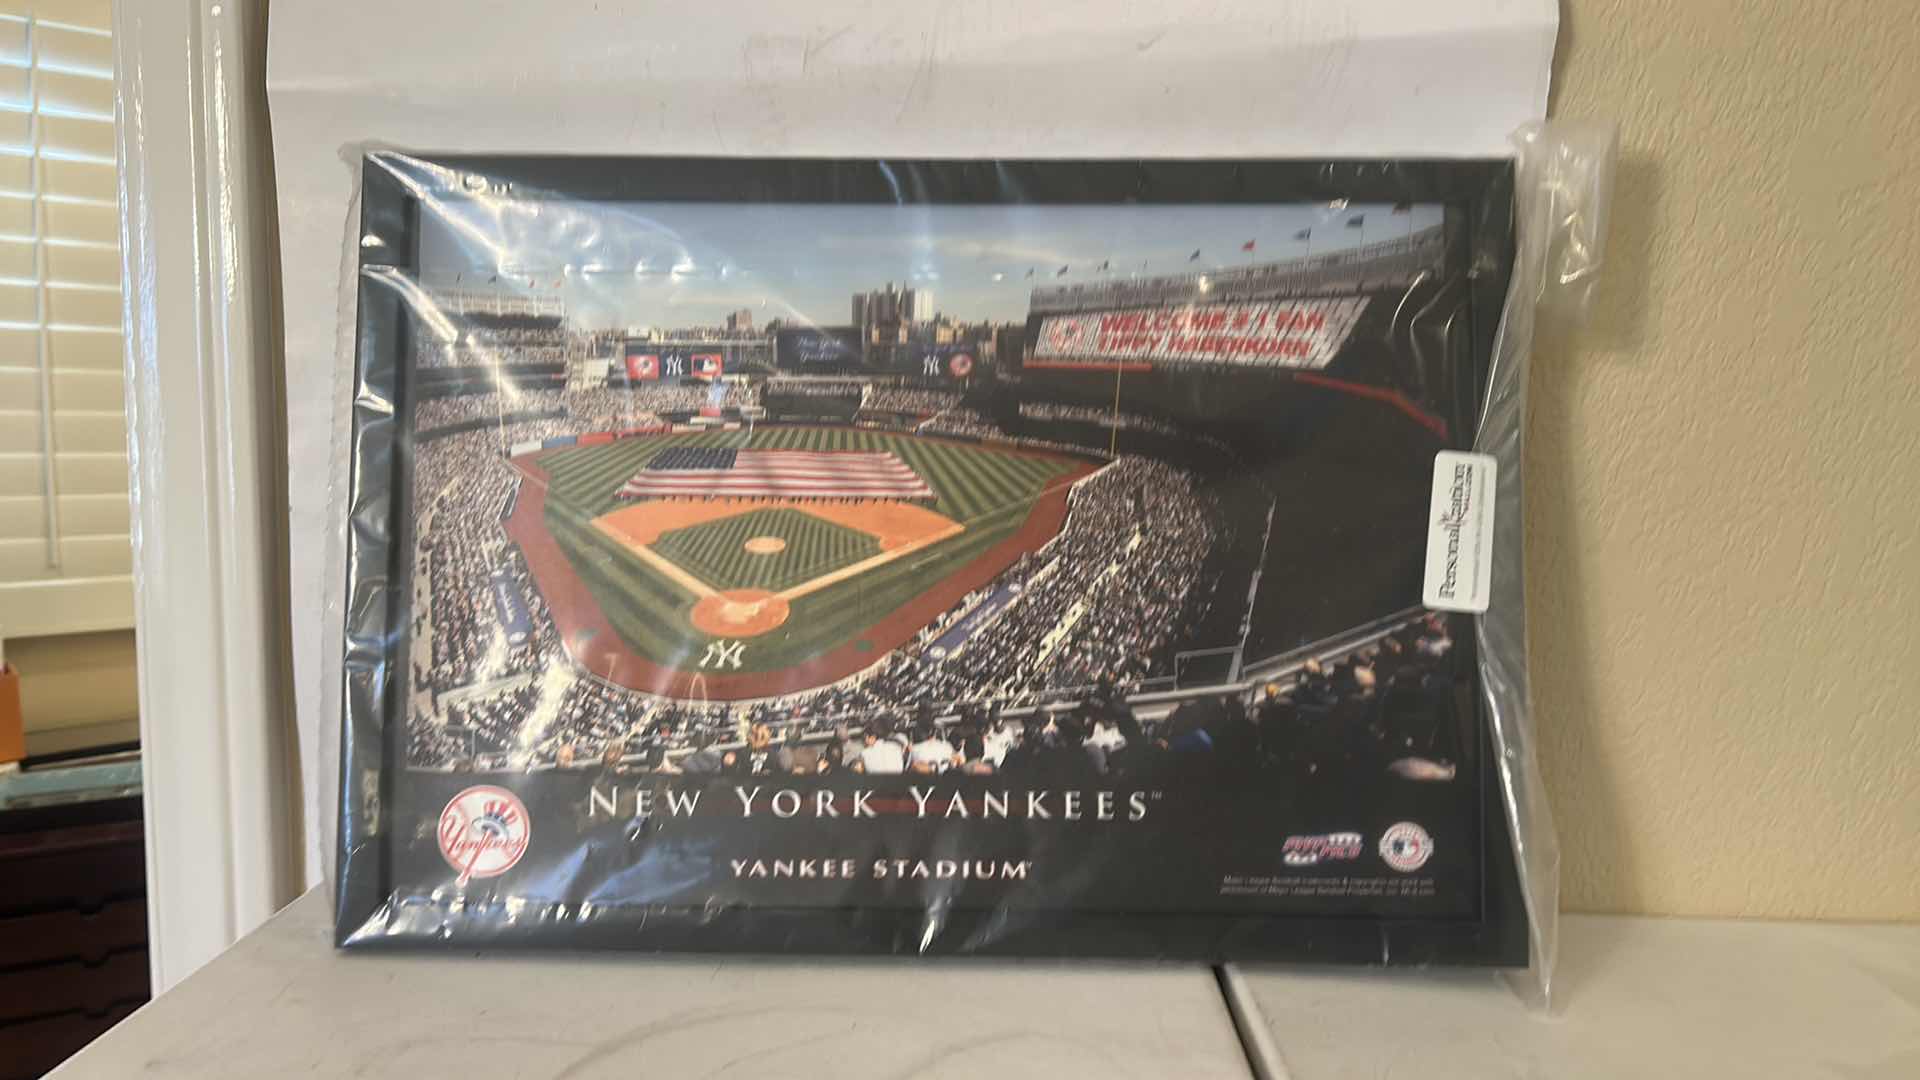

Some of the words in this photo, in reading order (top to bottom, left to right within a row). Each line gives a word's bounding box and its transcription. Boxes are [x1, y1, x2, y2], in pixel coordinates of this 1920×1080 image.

[1101, 311, 1226, 333] WELCOME
[588, 783, 701, 817] NEW
[735, 785, 876, 818] YORK
[730, 858, 857, 879] YANKEE
